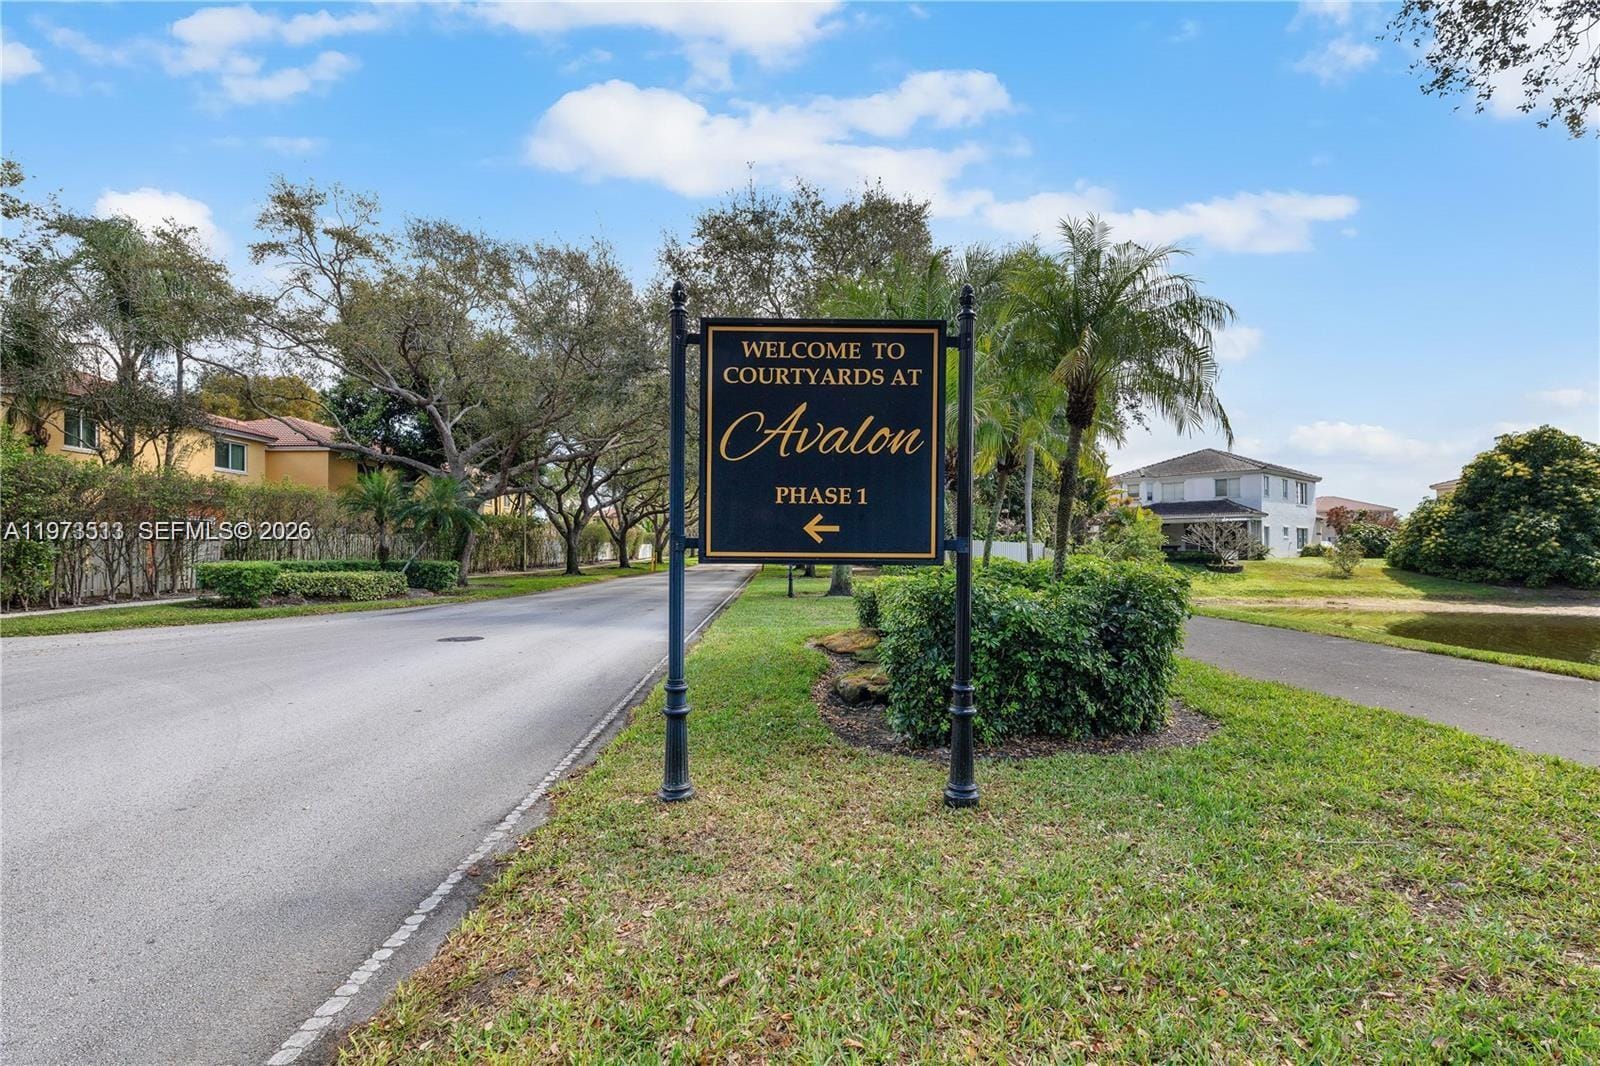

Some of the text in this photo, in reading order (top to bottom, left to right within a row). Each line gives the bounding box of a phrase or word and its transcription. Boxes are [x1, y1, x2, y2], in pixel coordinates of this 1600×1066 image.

[742, 341, 905, 360] WELCOME TO
[723, 366, 922, 386] COURTYARDS AT
[719, 402, 925, 462] Avalon
[775, 486, 868, 505] PHASE 1
